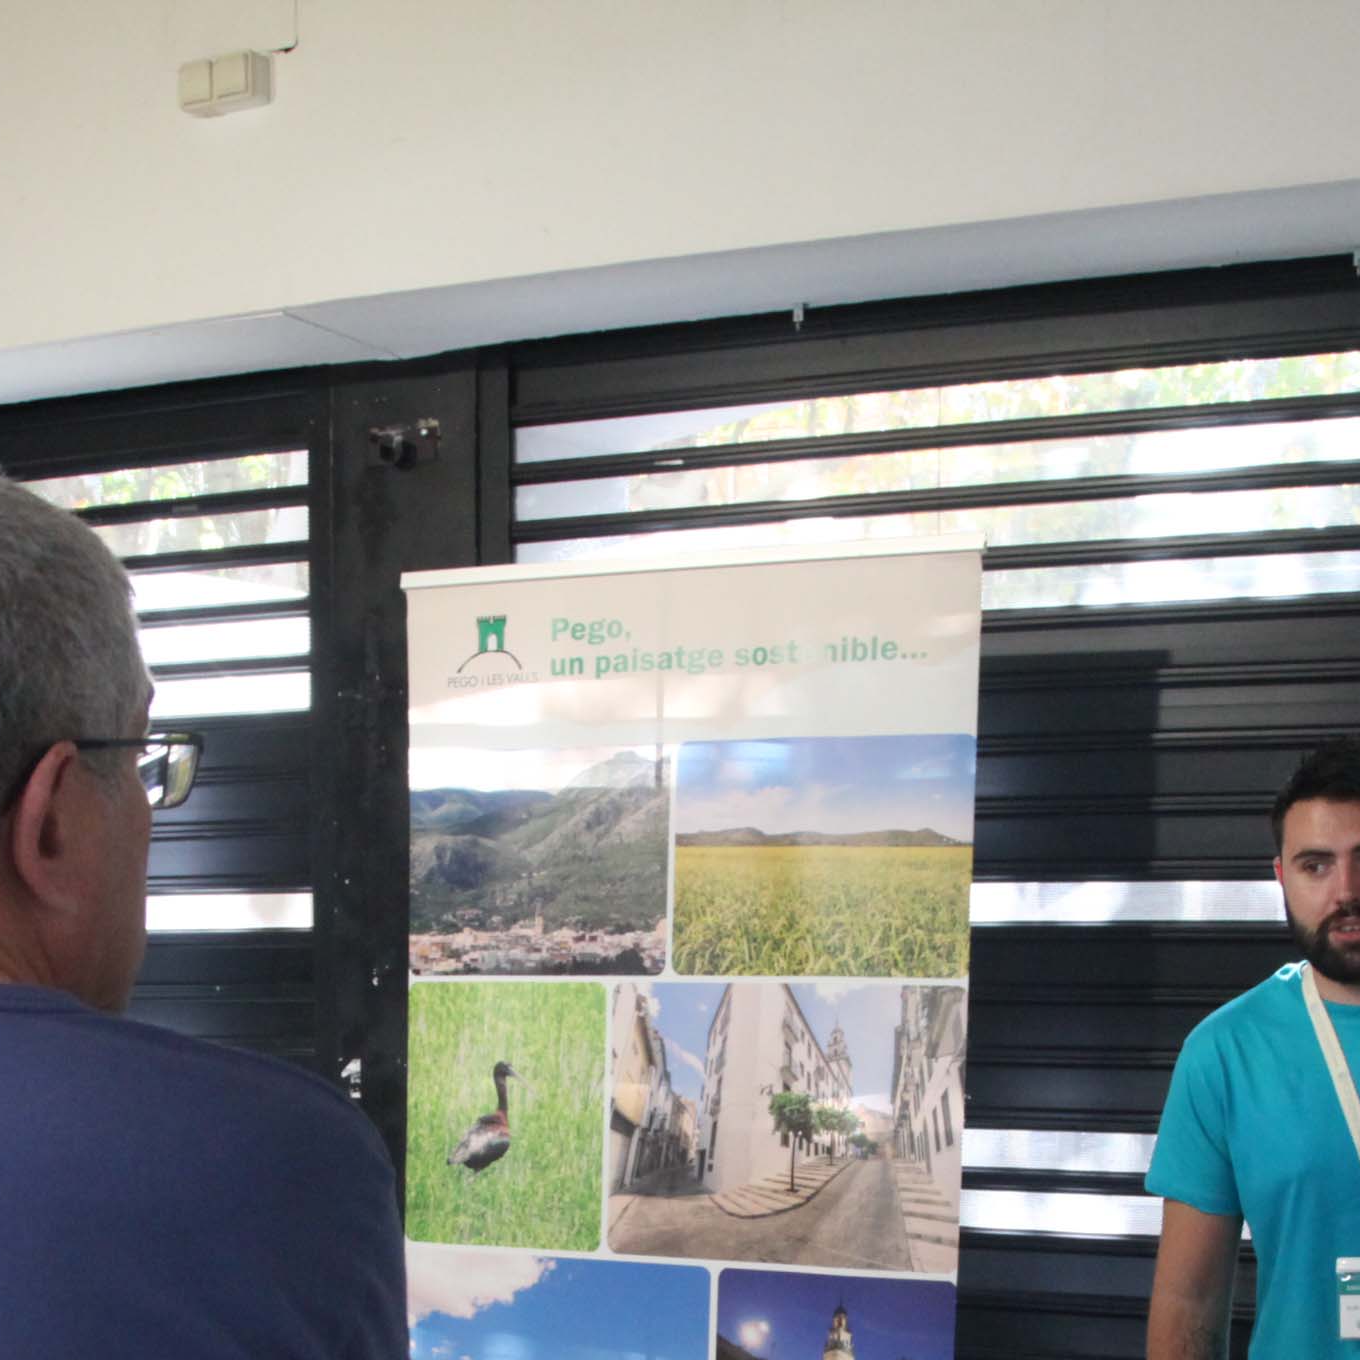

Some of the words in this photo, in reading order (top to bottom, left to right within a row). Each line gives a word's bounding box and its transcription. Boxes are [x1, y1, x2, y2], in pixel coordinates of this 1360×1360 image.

[550, 617, 632, 645] Pego,
[550, 655, 584, 677] un
[594, 644, 724, 680] paisatge
[734, 635, 929, 668] sostnible...
[446, 675, 479, 690] PEGO
[487, 674, 507, 686] LES
